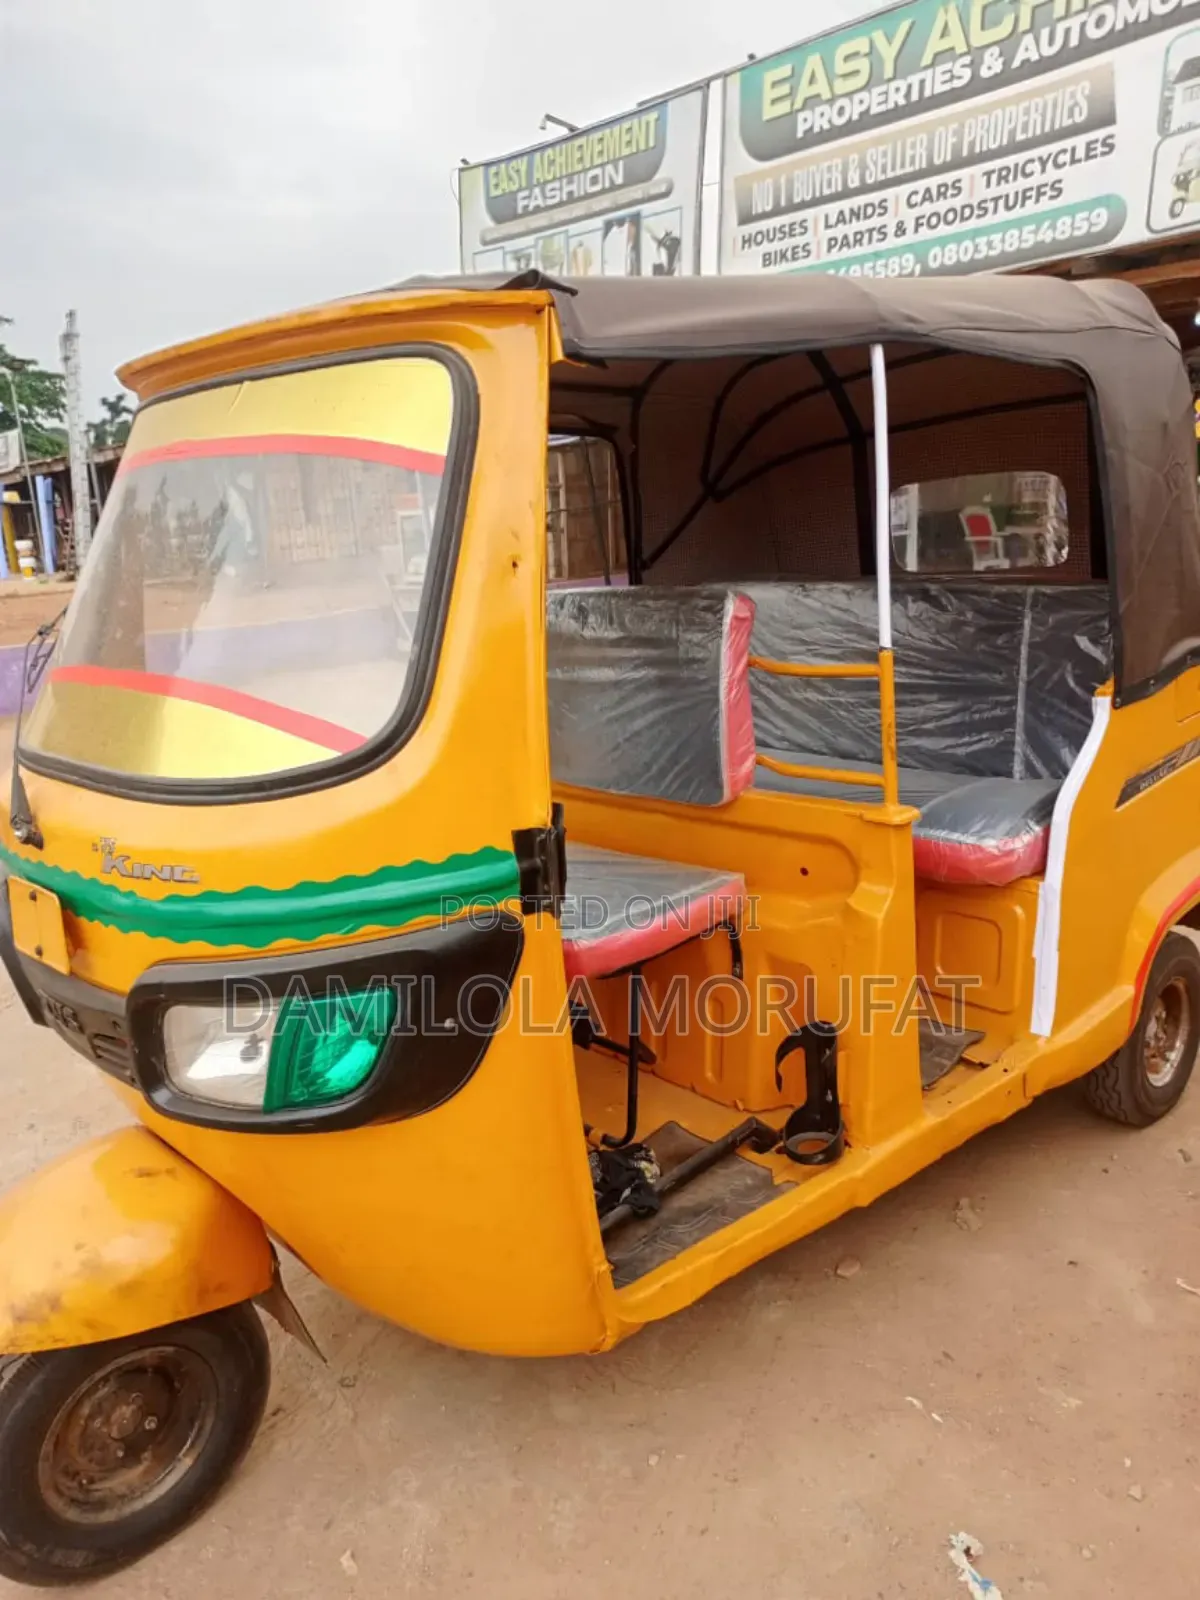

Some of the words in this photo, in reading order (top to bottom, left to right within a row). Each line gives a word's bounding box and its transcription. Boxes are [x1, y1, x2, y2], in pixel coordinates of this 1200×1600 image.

[762, 18, 915, 121] EASY
[796, 55, 973, 139] PROPERTIES
[979, 46, 1005, 79] &
[488, 158, 529, 198] EASY
[533, 111, 660, 185] ACHIEVEMENT
[516, 160, 625, 215] FASHION
[741, 219, 808, 251] HOUSES
[824, 198, 888, 230] LANDS
[906, 178, 963, 209] CARS
[982, 133, 1117, 189] TRICYCLES
[752, 178, 773, 215] NO
[780, 173, 787, 208] 1
[793, 158, 842, 204] BUYER
[847, 153, 861, 188] &
[865, 133, 928, 184] SELLER
[933, 124, 959, 166] OF
[961, 80, 1091, 157] PROPERTIES
[761, 242, 812, 268] BIKES
[827, 225, 888, 253] PARTS
[893, 219, 907, 238] &
[914, 179, 1064, 234] FOODSTUFFS
[928, 207, 1109, 269] 08033854859
